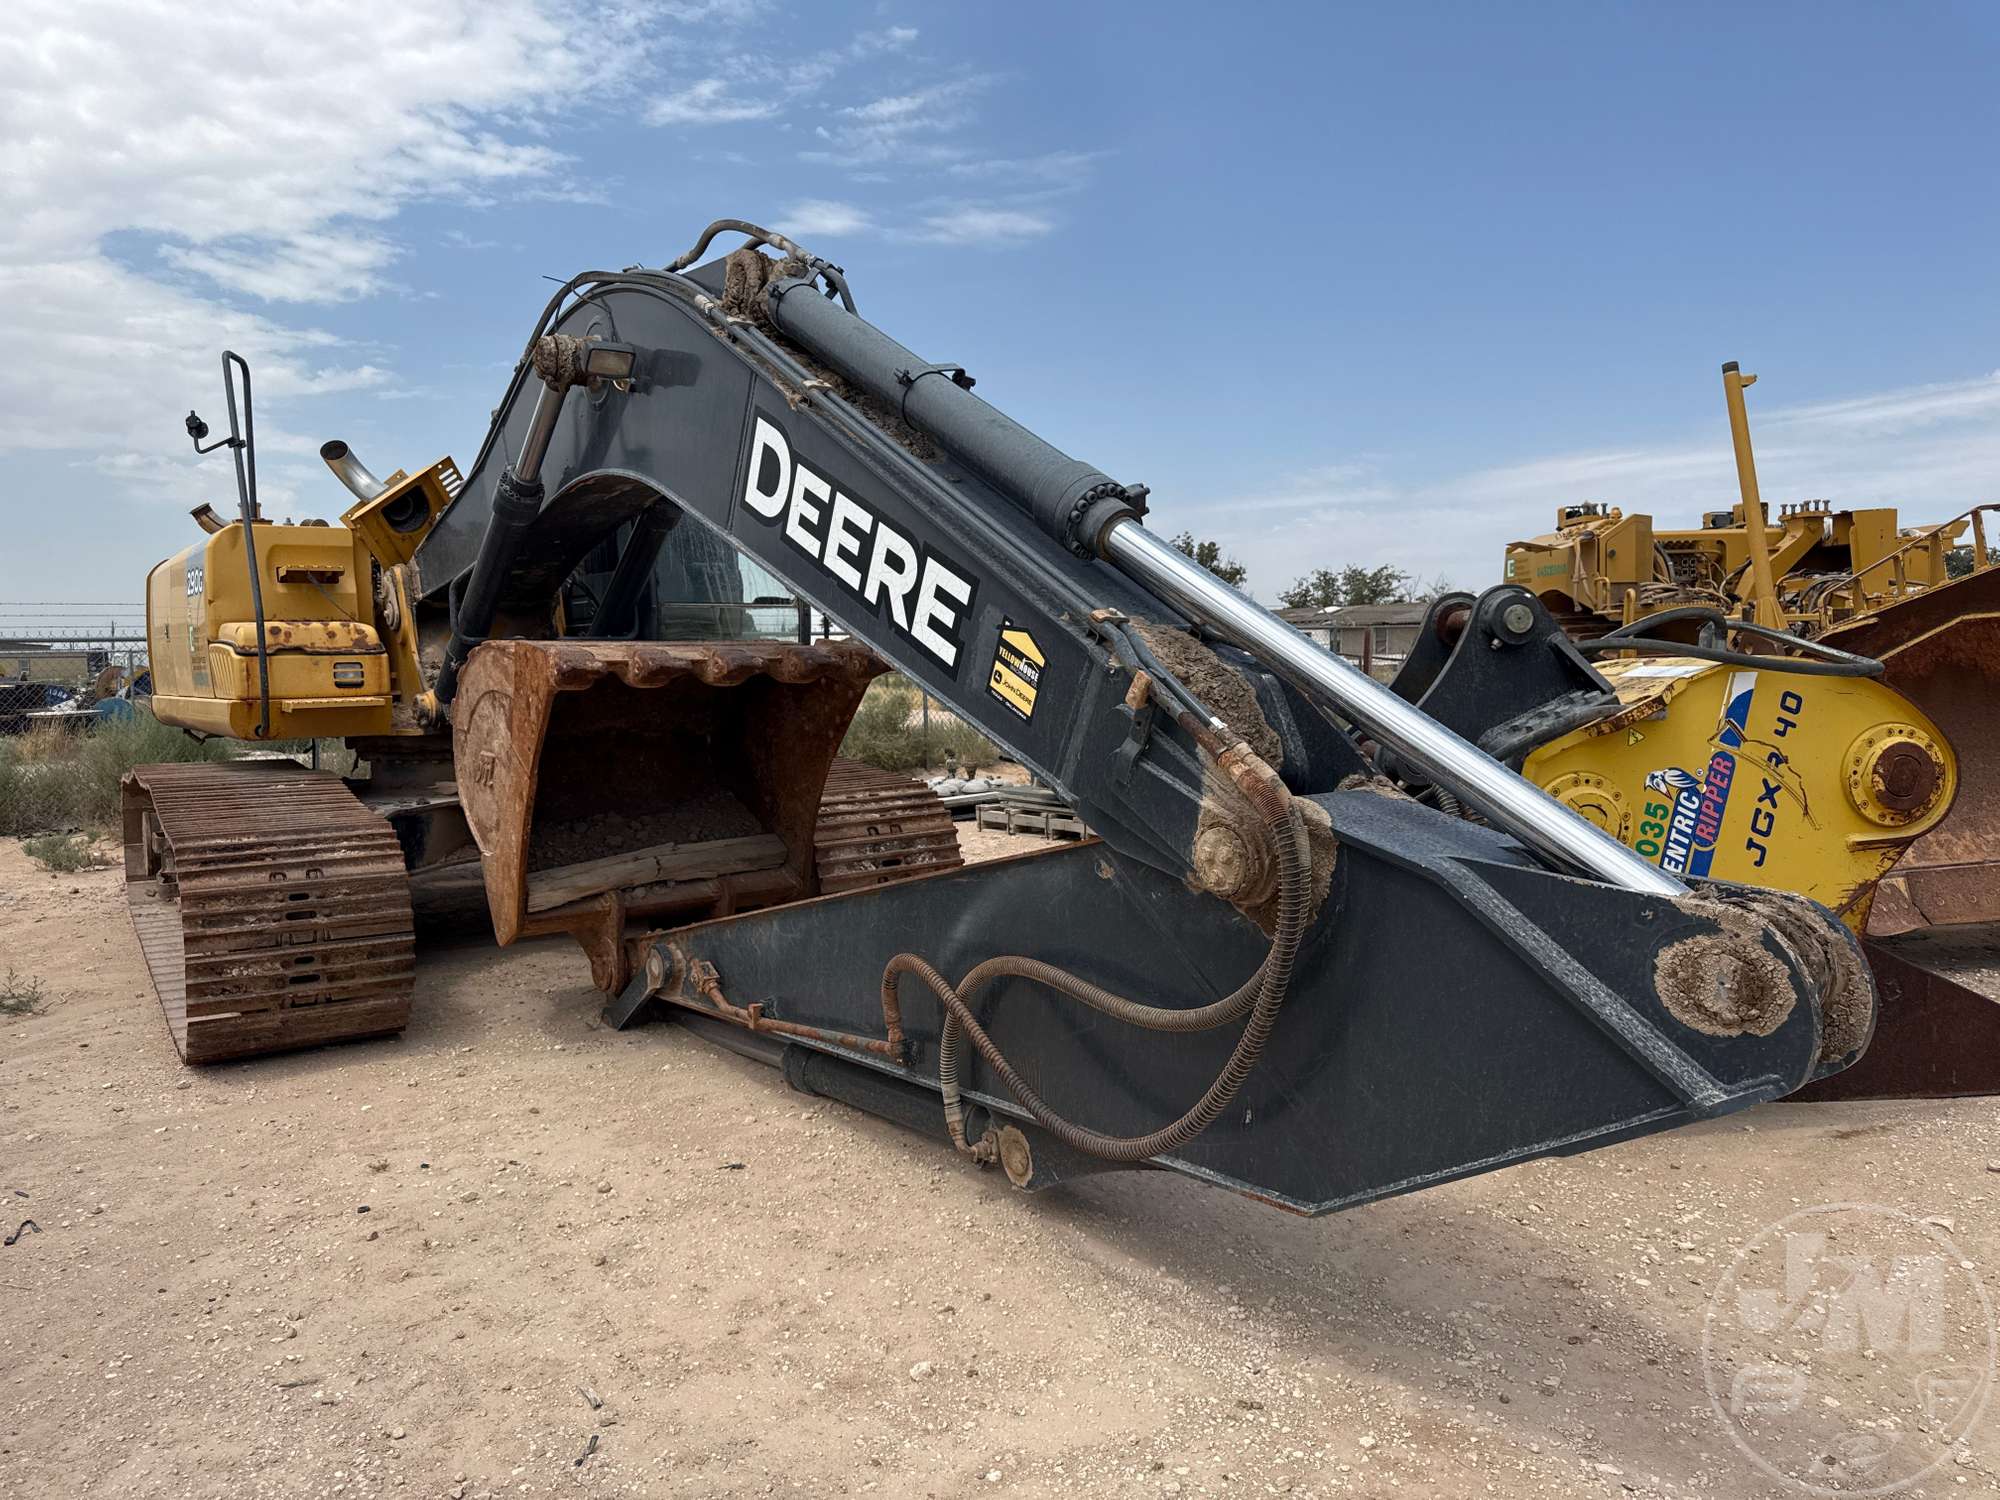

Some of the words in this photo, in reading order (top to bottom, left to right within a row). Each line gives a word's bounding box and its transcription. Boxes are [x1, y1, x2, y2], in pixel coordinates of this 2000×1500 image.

[744, 416, 972, 667] DEERE
[1635, 802, 1669, 857] 035
[1663, 792, 1701, 873] ENTRIC
[1695, 756, 1733, 842] RIPPER
